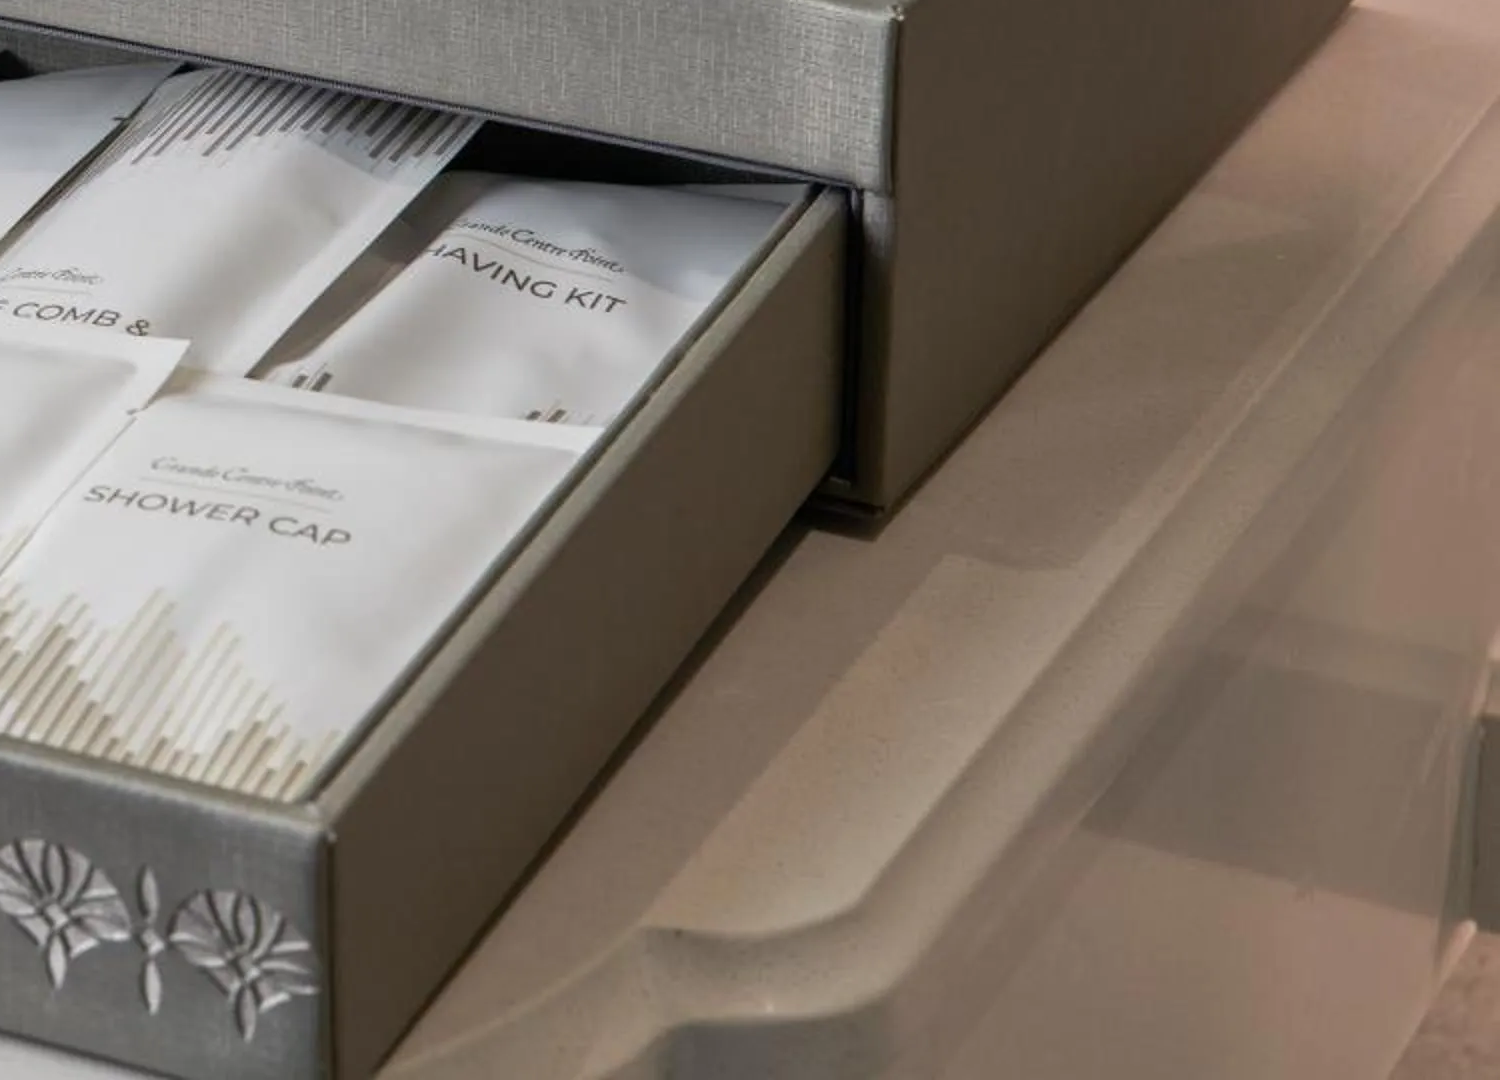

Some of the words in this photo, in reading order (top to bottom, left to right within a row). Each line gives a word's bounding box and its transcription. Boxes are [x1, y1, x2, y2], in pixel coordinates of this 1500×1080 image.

[510, 228, 567, 257] Centre
[564, 287, 628, 314] KIT
[12, 301, 122, 328] COMB
[126, 318, 151, 337] &
[83, 483, 261, 527] SHOWER
[267, 516, 353, 546] CAP
